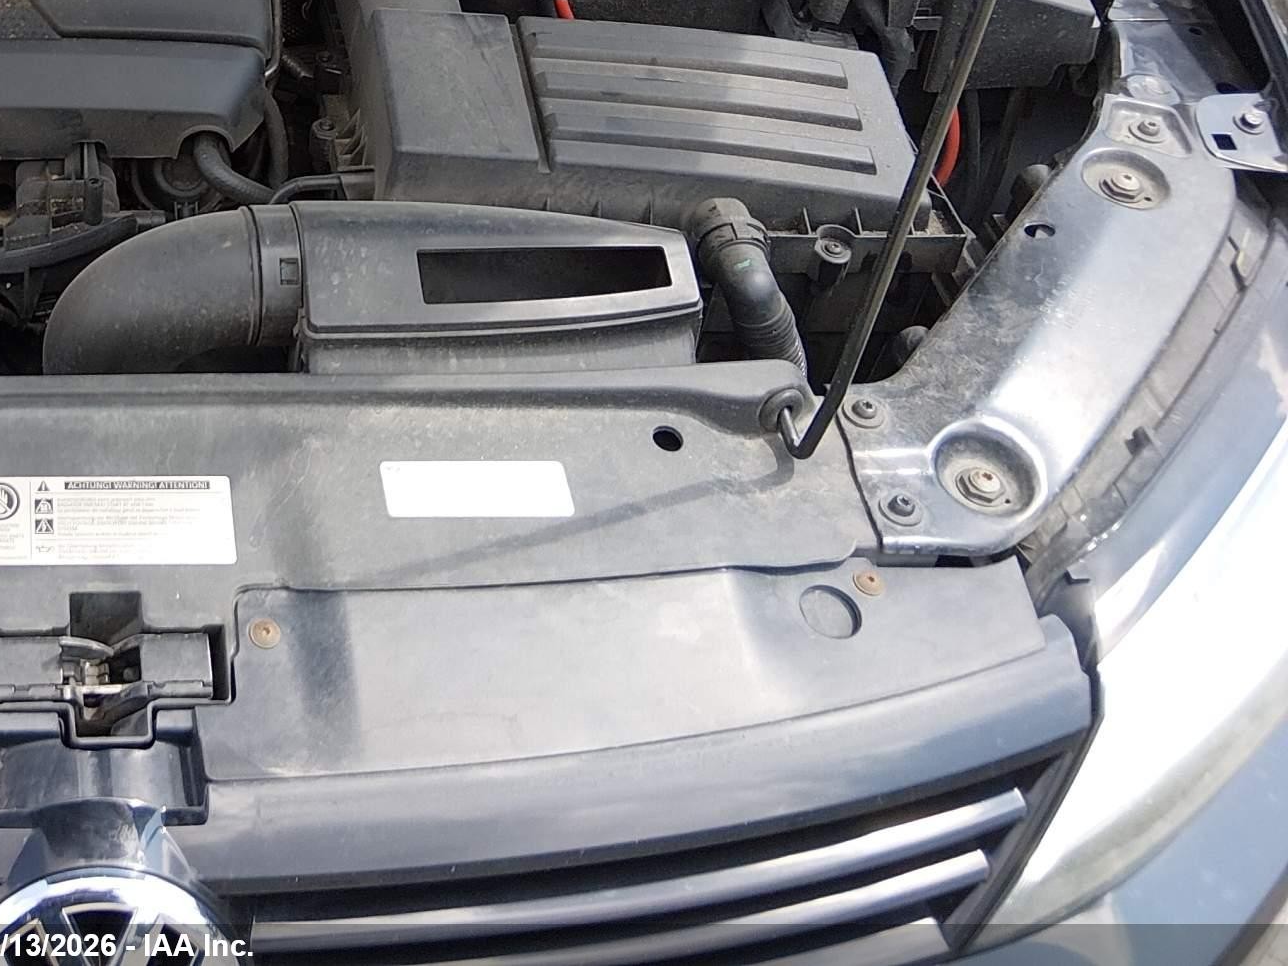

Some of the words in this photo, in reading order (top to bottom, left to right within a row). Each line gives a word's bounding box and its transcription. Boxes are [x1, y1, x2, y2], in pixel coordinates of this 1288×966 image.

[68, 480, 112, 490] ACHTUNG!
[113, 480, 157, 490] WARNING!
[159, 480, 208, 490] ATTENTION!
